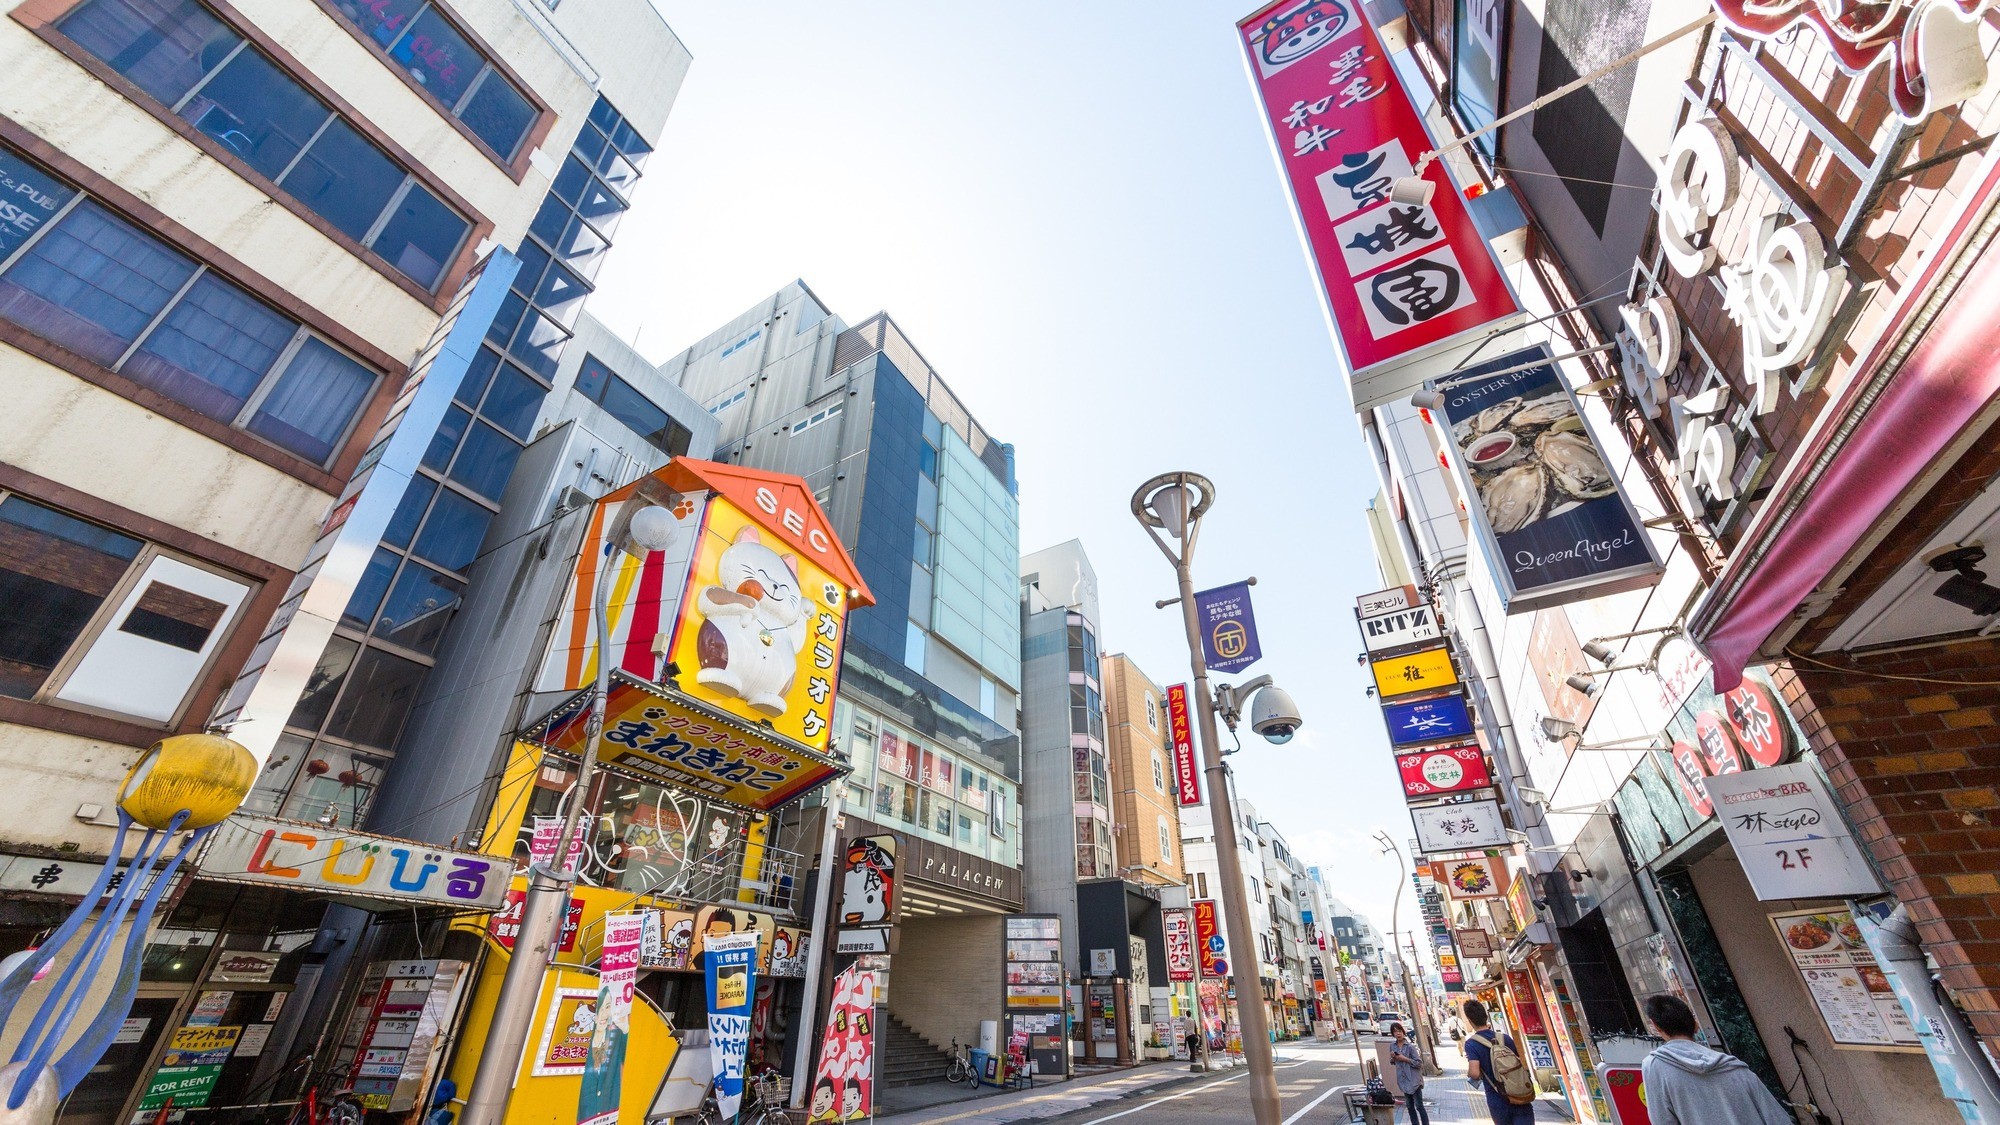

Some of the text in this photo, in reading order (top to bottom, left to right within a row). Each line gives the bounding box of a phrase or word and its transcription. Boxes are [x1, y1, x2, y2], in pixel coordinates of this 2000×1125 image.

[1329, 44, 1392, 109] 黒毛
[1281, 94, 1345, 157] 和牛
[15, 182, 57, 212] PUB
[1451, 376, 1511, 408] OYSTER
[1510, 360, 1544, 383] BAR
[753, 485, 830, 554] SEC
[1363, 595, 1404, 614] 三笑ビル
[1366, 609, 1429, 637] RITZ
[1412, 626, 1433, 639] ビル
[803, 612, 840, 739] カラオケ
[1402, 665, 1425, 682] 雅
[1170, 687, 1189, 742] カラオケ
[602, 717, 789, 793] まねきねこ
[661, 714, 787, 772] カラオケ本舗
[1178, 742, 1196, 801] SHIDAX
[1426, 769, 1461, 783] 悟空林
[1472, 777, 1485, 786] 3F
[1779, 781, 1812, 796] BAR
[1445, 806, 1463, 816] Club
[1440, 818, 1480, 837] 紫苑
[246, 828, 492, 900] にじびる
[1774, 847, 1813, 872] 2F
[924, 857, 992, 889] PALACE
[398, 964, 428, 976] ご案内
[176, 1028, 240, 1044] テナント募集
[179, 1040, 226, 1049] FOR RENT
[550, 1043, 590, 1061] まねきね
[150, 1075, 214, 1095] FOR RENT
